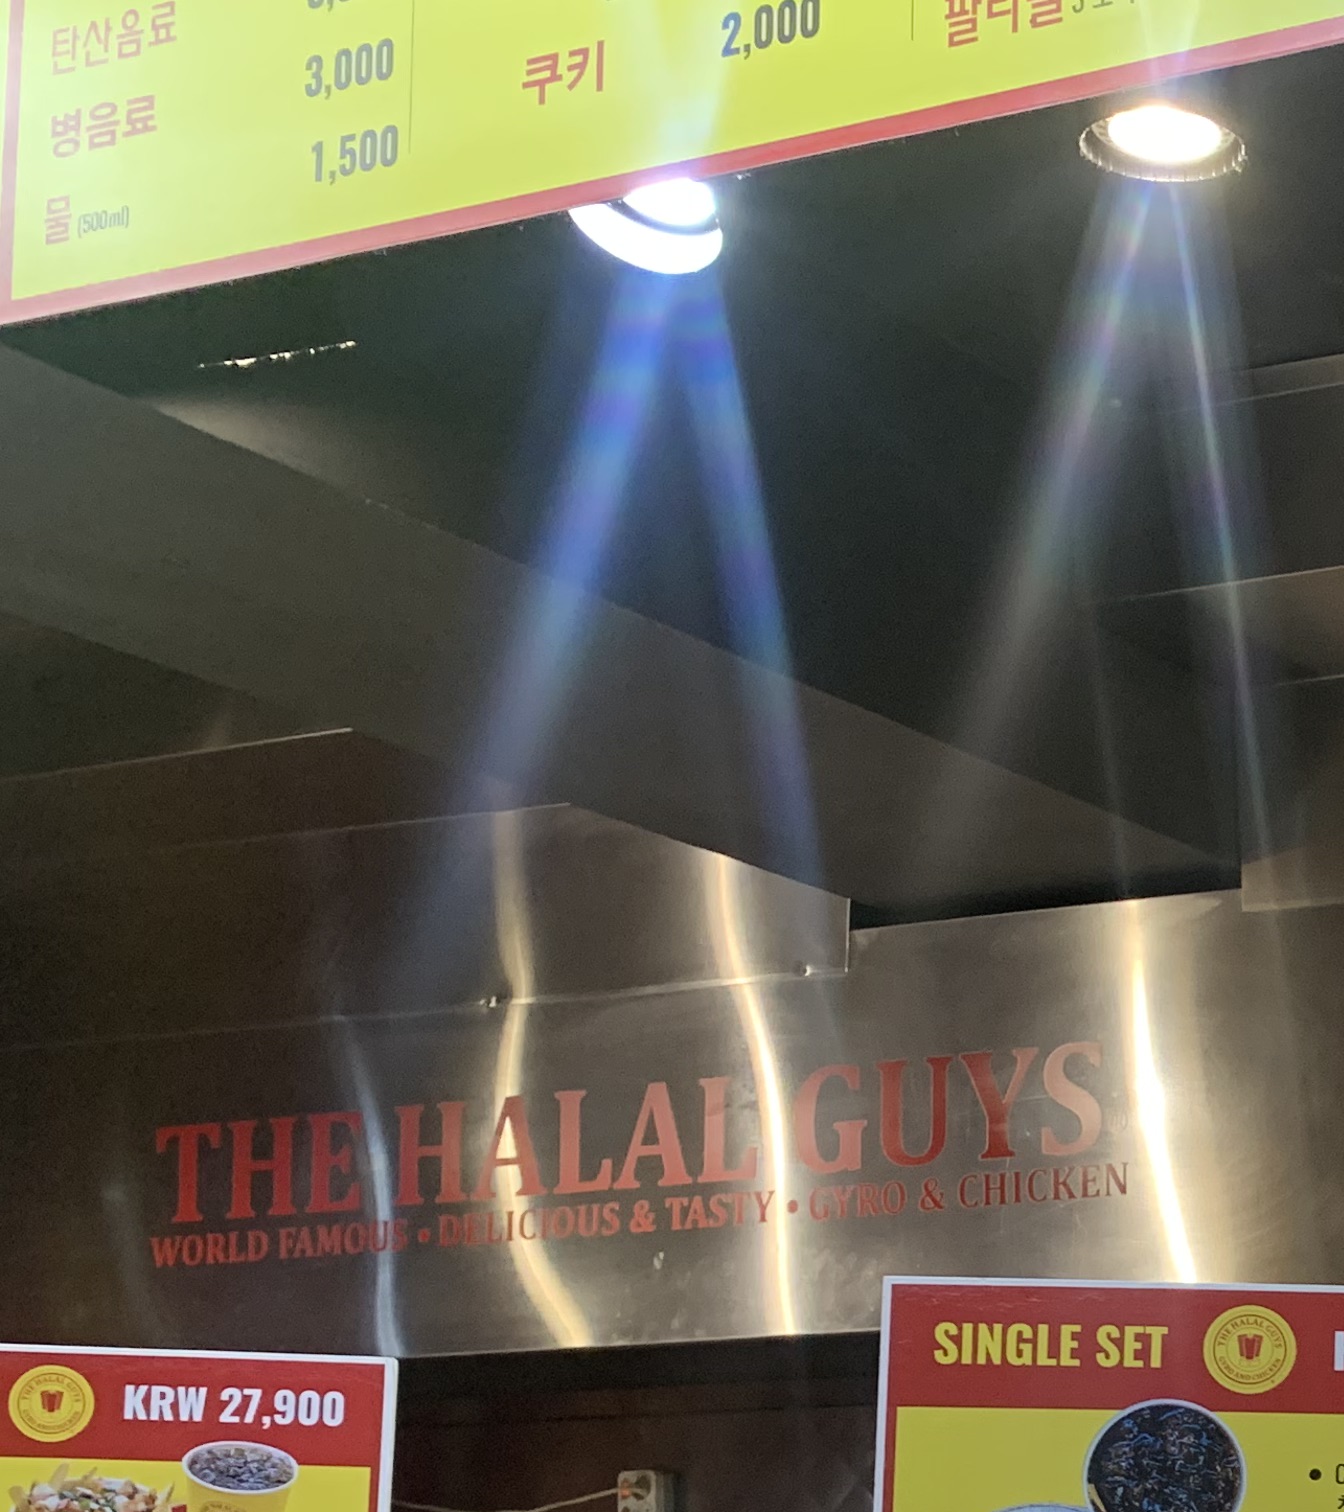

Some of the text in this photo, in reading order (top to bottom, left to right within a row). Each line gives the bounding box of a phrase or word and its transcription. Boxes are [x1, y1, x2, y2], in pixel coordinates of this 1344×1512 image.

[51, 0, 178, 76] 탄산음료
[721, 0, 821, 60] 2,000
[304, 38, 394, 99] 3,000
[522, 40, 605, 105] 쿠키
[50, 94, 158, 158] 병음료
[311, 124, 399, 185] 1,500
[44, 195, 130, 245] 물 (500ml)
[156, 1041, 1102, 1223] THE HALAL GUYS
[149, 1162, 1130, 1268] WORLD FAMOUS DELICIOUS & TASTY GYRO & CHICKEN
[934, 1322, 1169, 1368] SINGLE SET
[123, 1384, 207, 1423] KRW
[218, 1386, 346, 1430] 27,900
